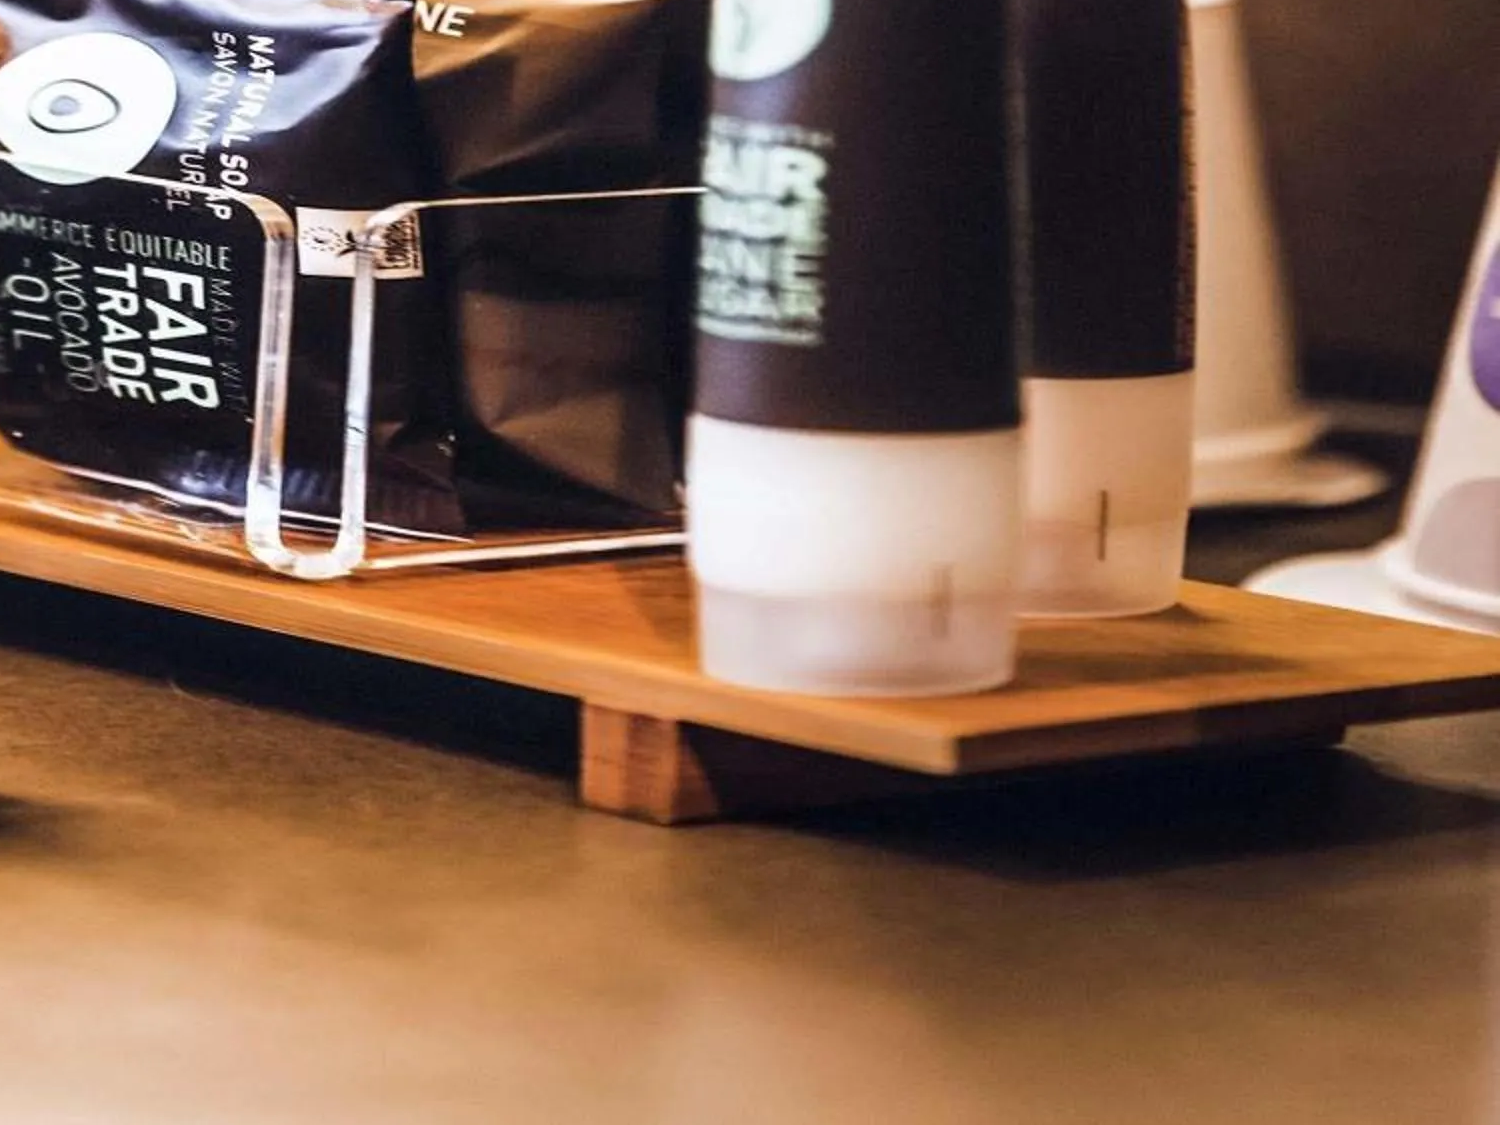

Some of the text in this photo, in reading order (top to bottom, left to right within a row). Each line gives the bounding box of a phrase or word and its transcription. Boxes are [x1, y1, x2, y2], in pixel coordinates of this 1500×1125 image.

[165, 31, 238, 212] SAVON NATUREL
[204, 35, 275, 220] NATURAL SOAP
[105, 228, 232, 272] EQUITABLE
[51, 252, 100, 392] AVOCADO
[93, 262, 156, 404] TRADE
[143, 266, 221, 409] FAIR
